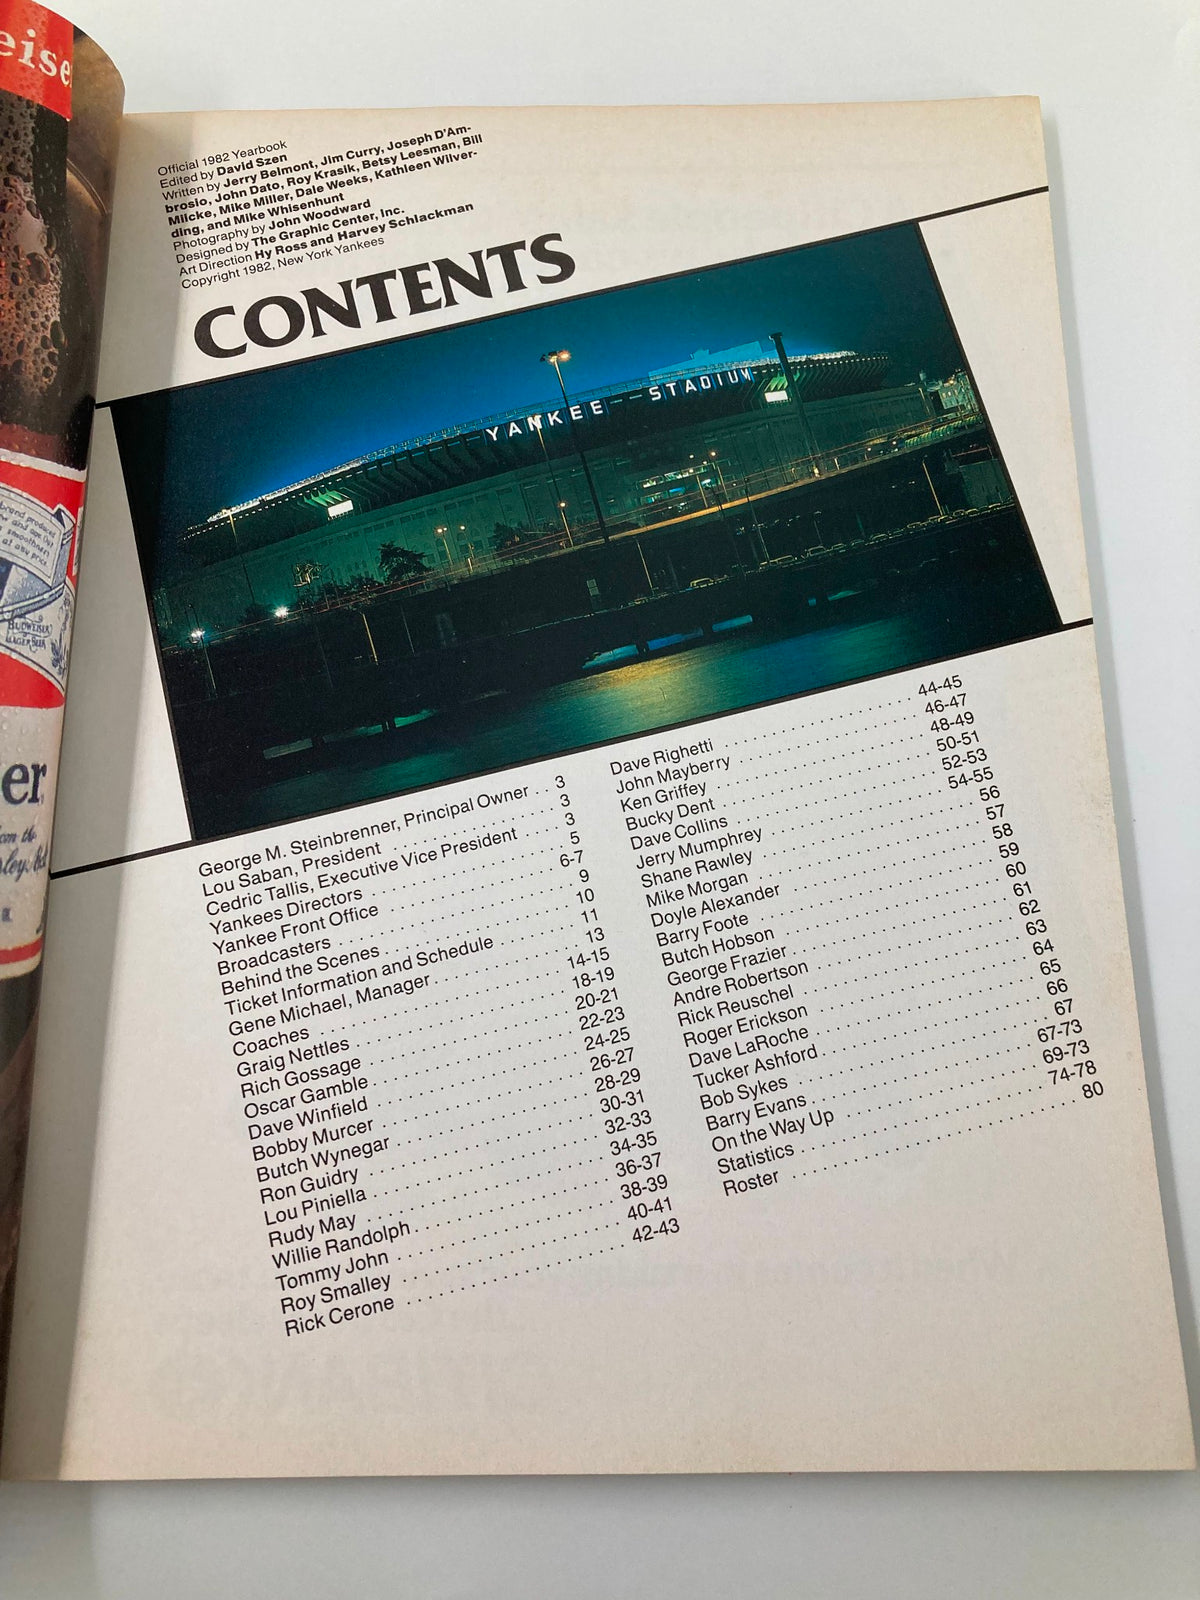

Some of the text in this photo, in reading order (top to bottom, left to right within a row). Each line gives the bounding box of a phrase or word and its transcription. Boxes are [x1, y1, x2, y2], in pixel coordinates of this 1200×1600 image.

[157, 140, 287, 176] Official 1982 Yearbook
[159, 154, 288, 189] Edited by David Szen
[161, 184, 204, 201] Written
[206, 182, 220, 192] by
[223, 174, 257, 188] Jerry
[260, 160, 318, 180] Belmont,
[320, 155, 344, 166] Jim
[346, 146, 385, 160] Curry,
[387, 133, 433, 151] Joseph
[214, 190, 247, 203] John
[249, 182, 284, 195] Dato,
[286, 175, 311, 187] Roy
[361, 155, 397, 169] Betsy
[399, 142, 460, 161] Leesman,
[462, 134, 483, 146] Bill
[218, 202, 251, 215] Mike
[253, 193, 293, 207] Miller,
[295, 185, 324, 198] Dale
[326, 175, 373, 190] Weeks,
[374, 161, 431, 180] Kathleen
[432, 151, 477, 166] Wilver-
[173, 198, 371, 251] Photography by John Woodward
[175, 207, 405, 264] Designed by The Graphic Center, Inc.
[180, 203, 474, 277] Art Direction Hy Ross and Harvey Schlackman
[181, 237, 385, 289] Copyright 1982, New York Yankees
[207, 217, 231, 231] and
[233, 212, 265, 225] Mike
[267, 192, 345, 217] Whisenhunt
[194, 232, 576, 359] CONTENTS
[485, 367, 753, 442] YANKEE STADIUM
[610, 674, 962, 775] Dave Righetti 44-45
[616, 693, 966, 794] John Mayberry 46-47
[198, 775, 565, 877] George M. Steinbrenner, Principal Owner 3
[625, 730, 979, 831] Bucky Dent 50-51
[636, 766, 994, 869] Jerry Mumphrey 54-55
[206, 812, 575, 916] Cedric Tallis, Executive Vice President 3
[212, 849, 583, 955] Yankee Front Office 6-7
[645, 803, 1004, 908] Mike Morgan 57
[656, 842, 1020, 947] Barry Foote 59
[217, 869, 589, 976] Broadcasters 9
[224, 908, 598, 1015] Ticket Information and Schedule 11
[667, 881, 1032, 986] George Frazier 61
[677, 919, 1047, 1027] Rick Reuschel 63
[229, 927, 605, 1036] Gene Michael, Manager 13
[237, 966, 615, 1077] Graig Nettles 18-19
[688, 958, 1061, 1068] Dave LaRoche 65
[248, 1026, 630, 1140] Dave Winfield 24-25
[699, 998, 1073, 1110] Bob Sykes 67
[712, 1039, 1090, 1152] On the Way Up 69-73
[256, 1067, 641, 1183] Butch Wynegar 28-29
[717, 1060, 1097, 1174] Statistics 74-78
[723, 1081, 1104, 1197] Roster 80
[268, 1130, 657, 1248] Rudy May 34-35
[285, 1218, 680, 1337] Rick Cerone 42-43
